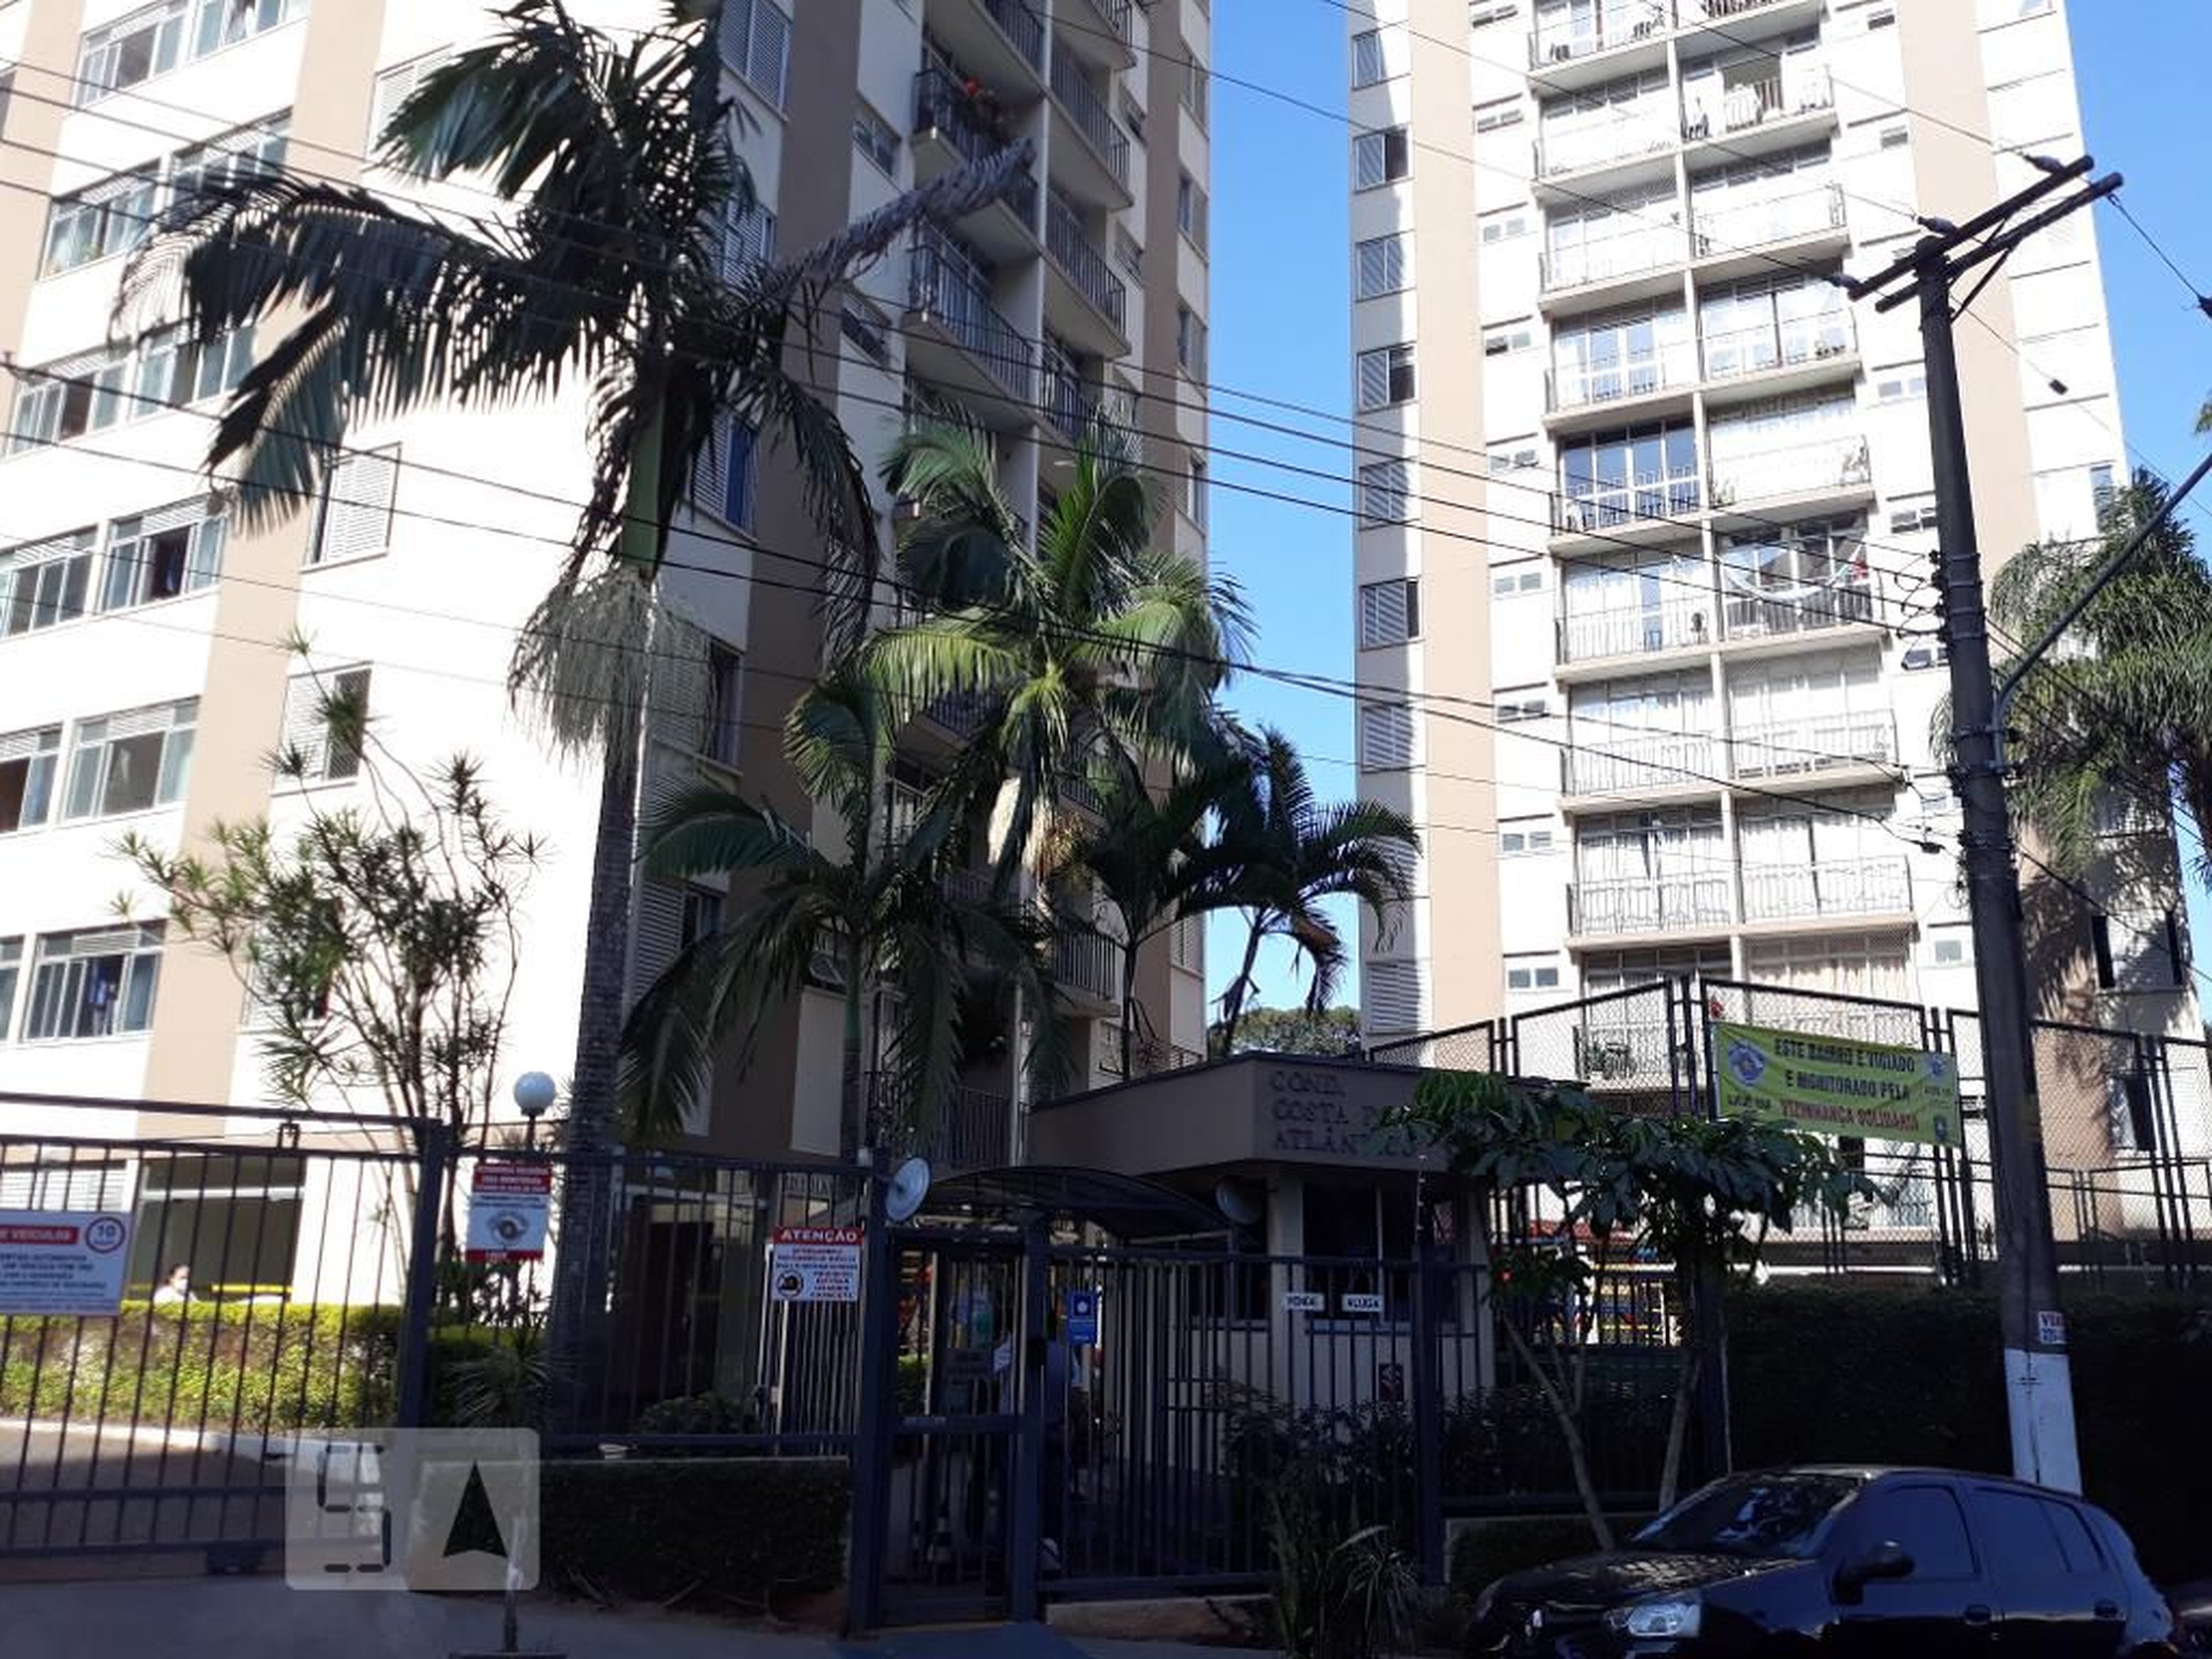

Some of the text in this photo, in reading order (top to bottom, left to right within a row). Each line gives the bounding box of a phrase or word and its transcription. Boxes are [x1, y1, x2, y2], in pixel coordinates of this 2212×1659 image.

[1775, 1039, 1804, 1058] ESTE
[1786, 1069, 1793, 1087] E
[1797, 1071, 1875, 1098] MONITORADO
[1880, 1081, 1909, 1100] PELA
[1273, 1098, 1349, 1124] COSTA
[782, 1229, 857, 1243] ATENÇÃO
